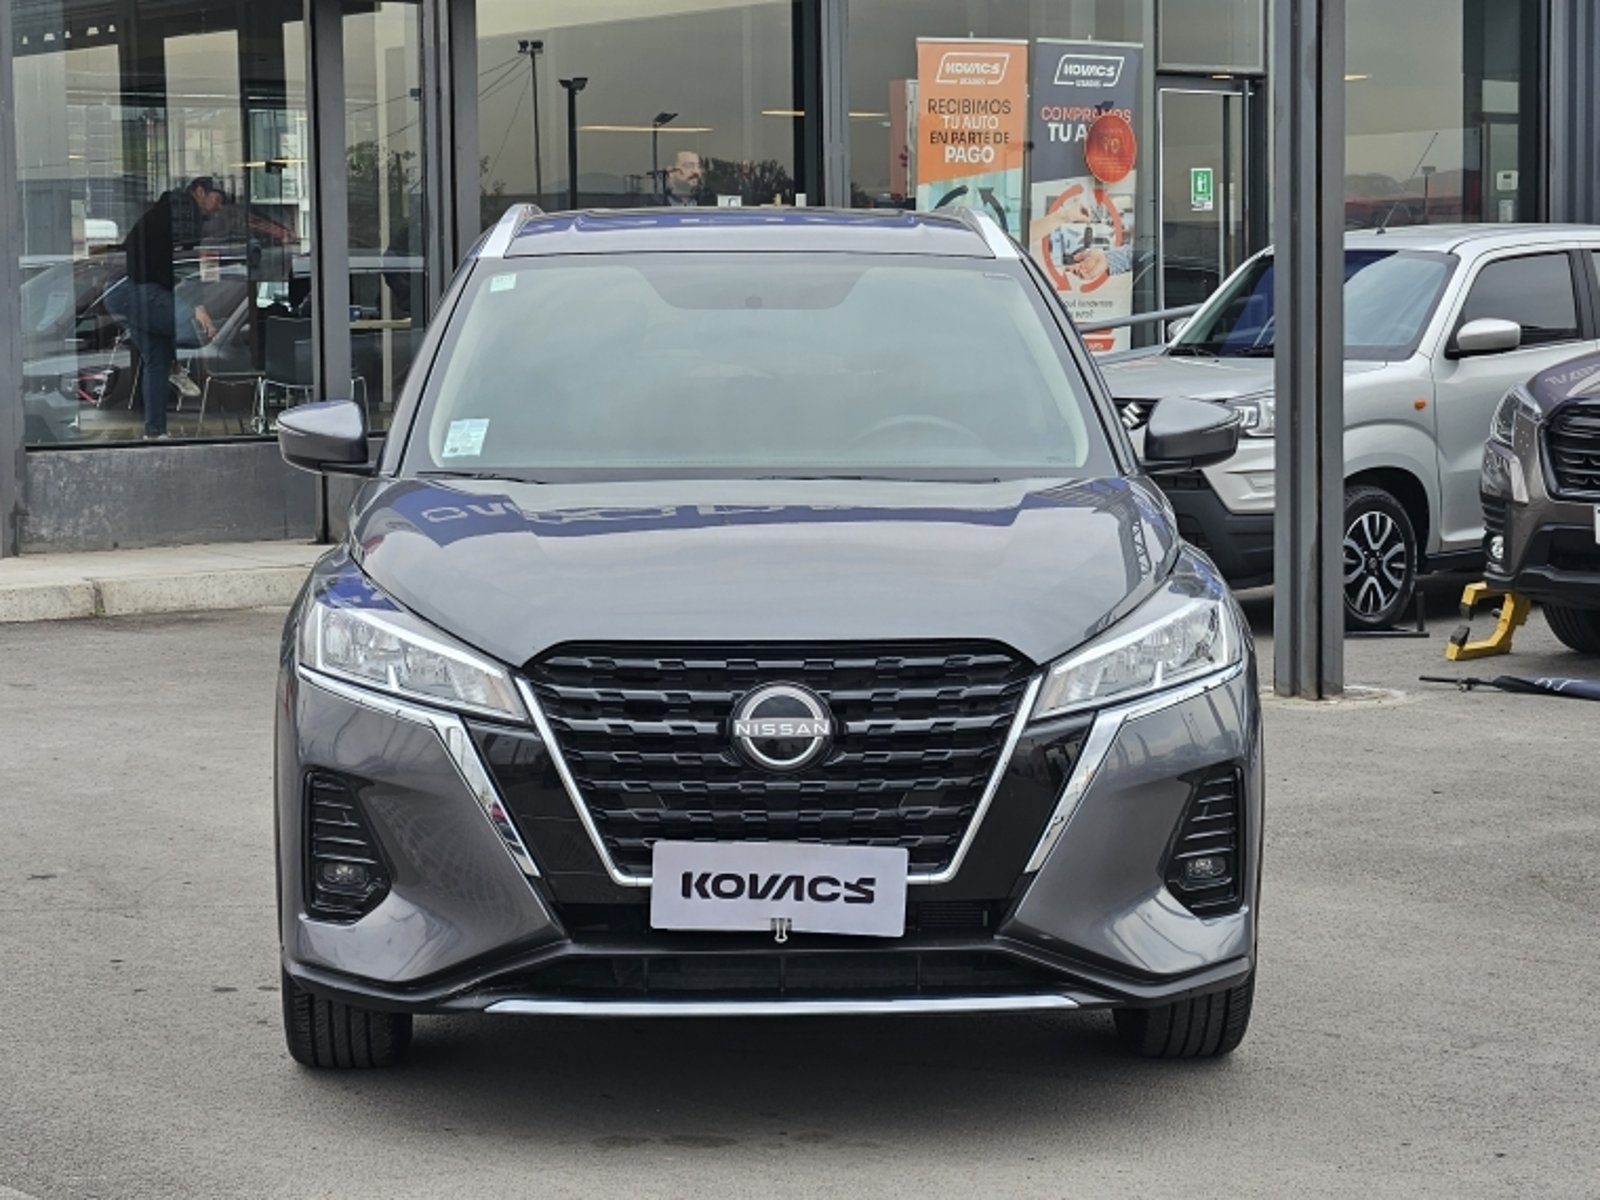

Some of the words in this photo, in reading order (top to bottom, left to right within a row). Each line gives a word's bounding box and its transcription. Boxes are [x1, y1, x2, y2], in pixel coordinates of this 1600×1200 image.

[945, 62, 1001, 75] KOVACS
[1063, 64, 1115, 77] KOVACS
[928, 98, 1012, 115] RECIBIMOS
[942, 115, 960, 129] TU
[962, 115, 999, 129] AUTO
[930, 131, 949, 145] EN
[951, 131, 990, 145] PARTE
[993, 132, 1010, 145] DE
[1047, 122, 1073, 142] TU
[944, 145, 995, 163] PAGO
[735, 723, 830, 736] NISSAN
[681, 871, 876, 904] KOVACS
